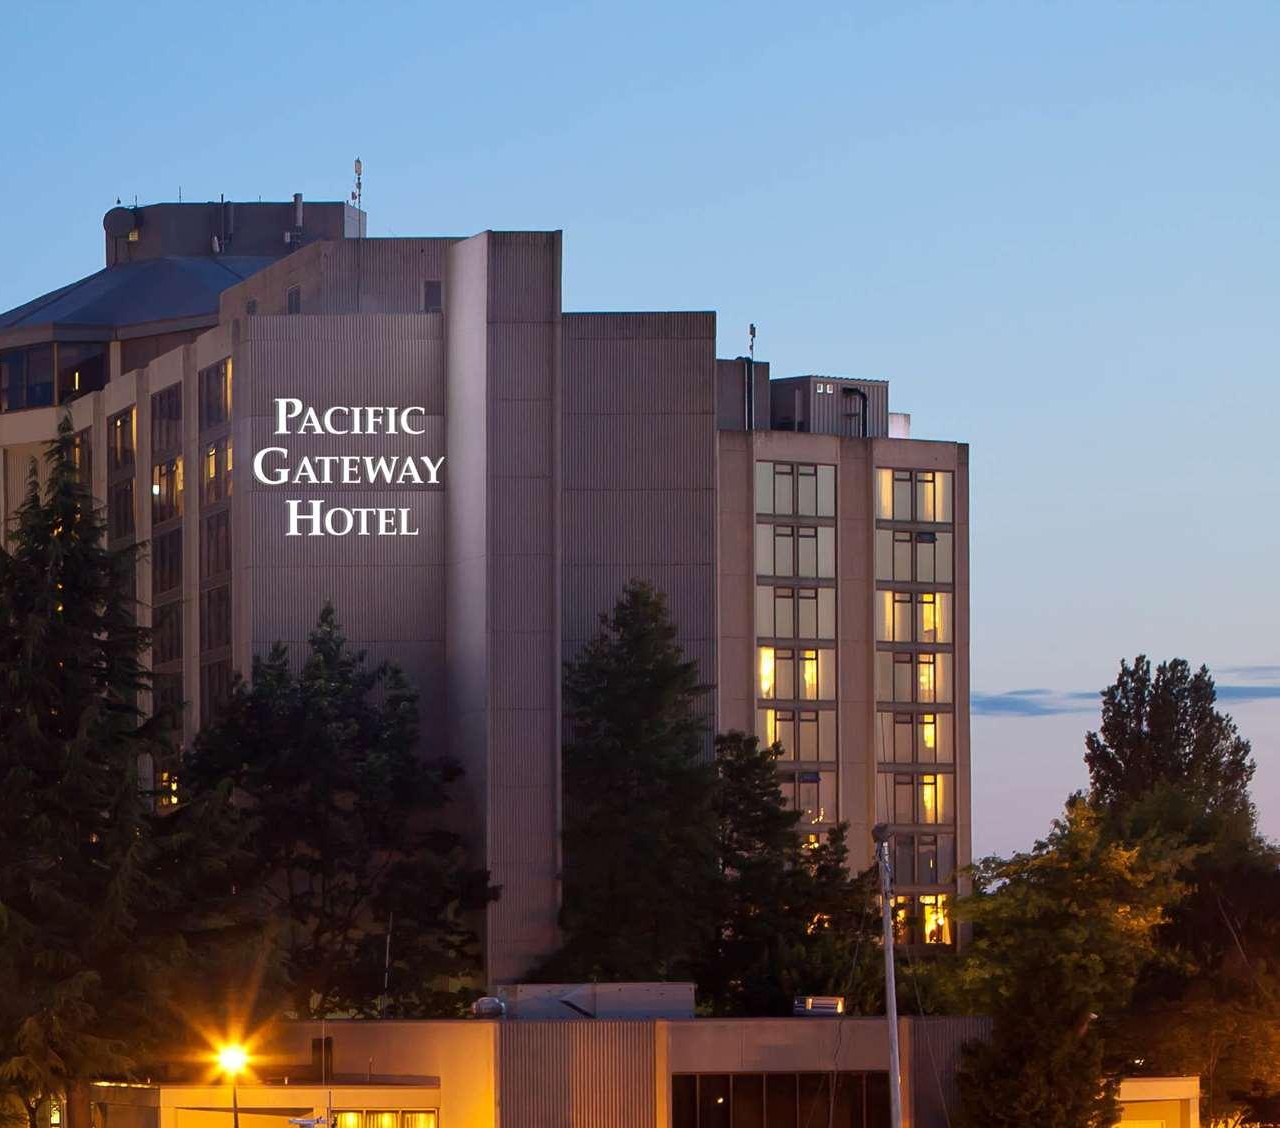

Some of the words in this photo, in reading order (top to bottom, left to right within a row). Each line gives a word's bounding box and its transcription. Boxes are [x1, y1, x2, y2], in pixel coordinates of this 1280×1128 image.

[273, 398, 426, 435] PACIFIC
[252, 446, 446, 486] GATEWAY
[285, 499, 420, 537] HOTEL
